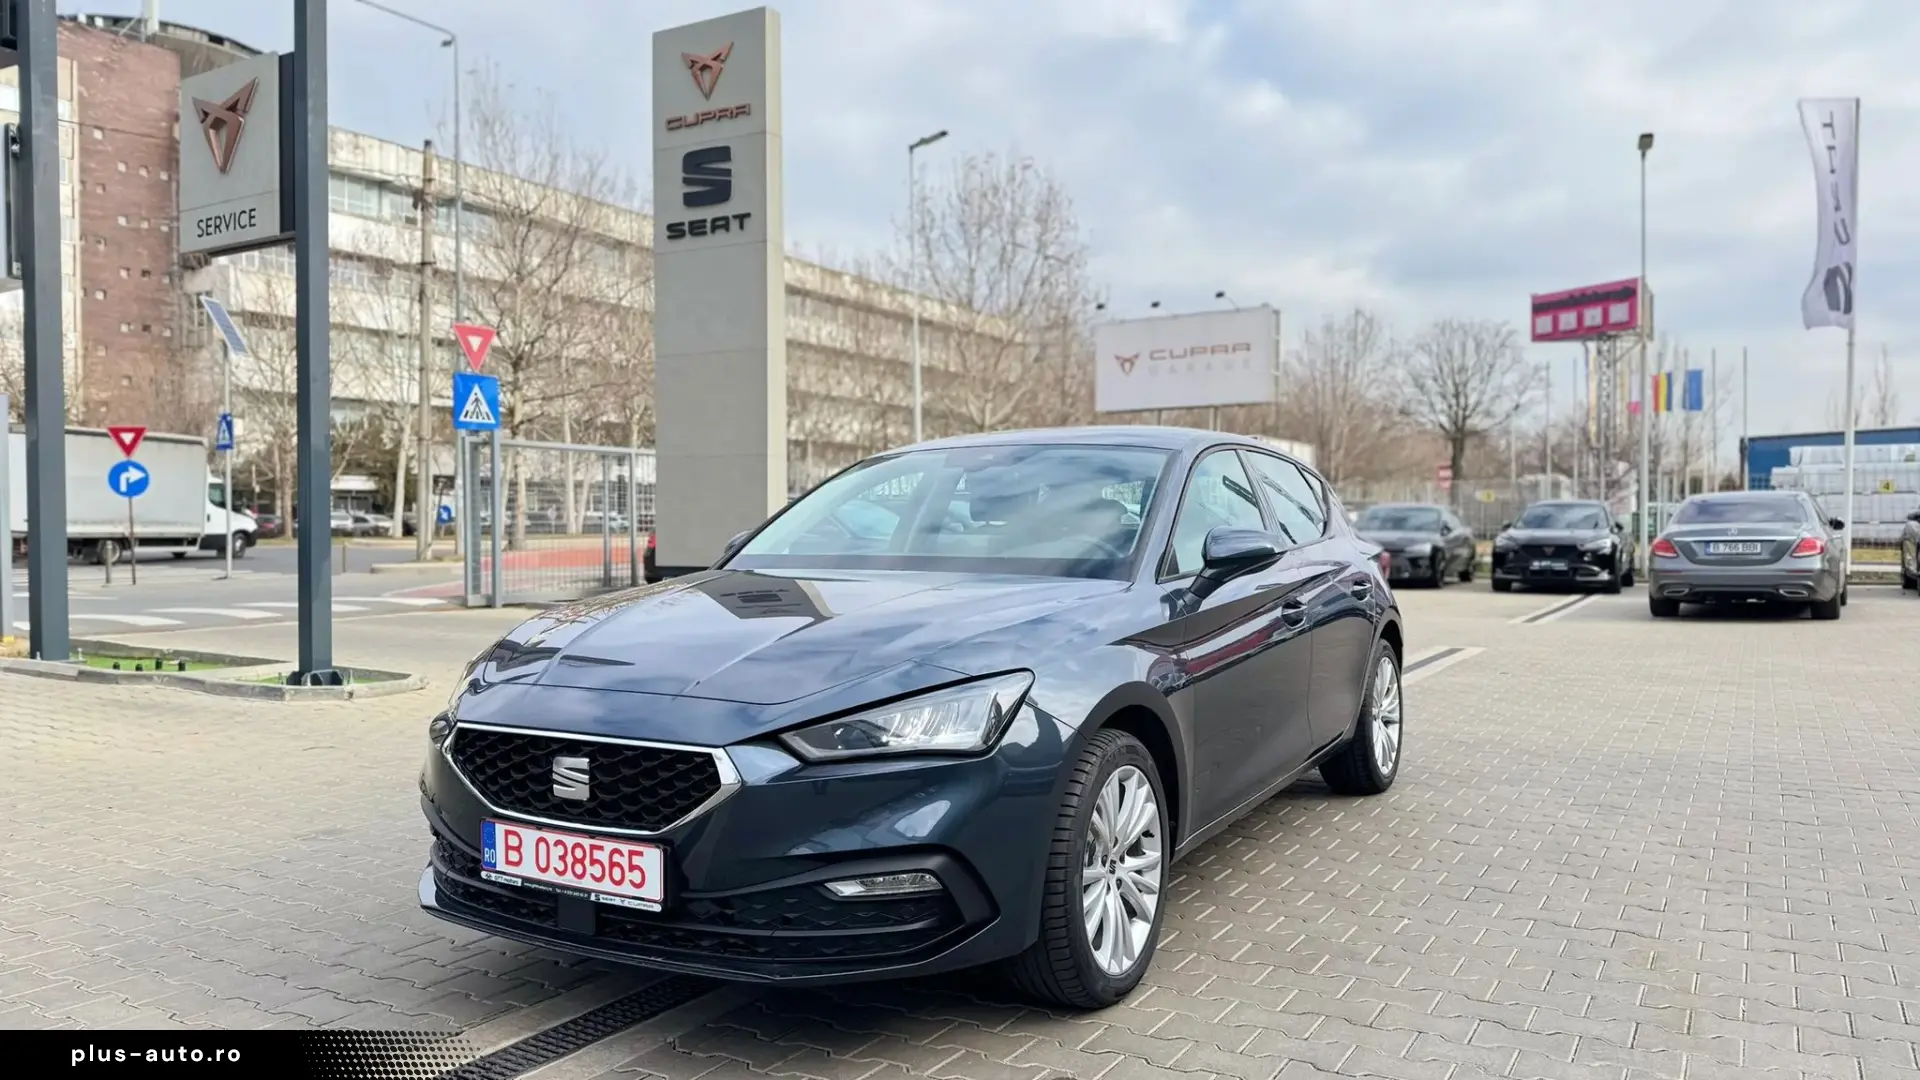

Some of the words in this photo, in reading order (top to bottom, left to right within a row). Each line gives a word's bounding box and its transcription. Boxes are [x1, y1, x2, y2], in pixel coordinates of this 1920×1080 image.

[666, 103, 752, 132] CUPRA
[197, 208, 257, 238] SERVICE
[666, 212, 752, 241] SEAT
[1149, 342, 1252, 361] CUPRA
[484, 848, 496, 864] RO
[504, 829, 523, 867] B
[535, 836, 646, 890] 038565
